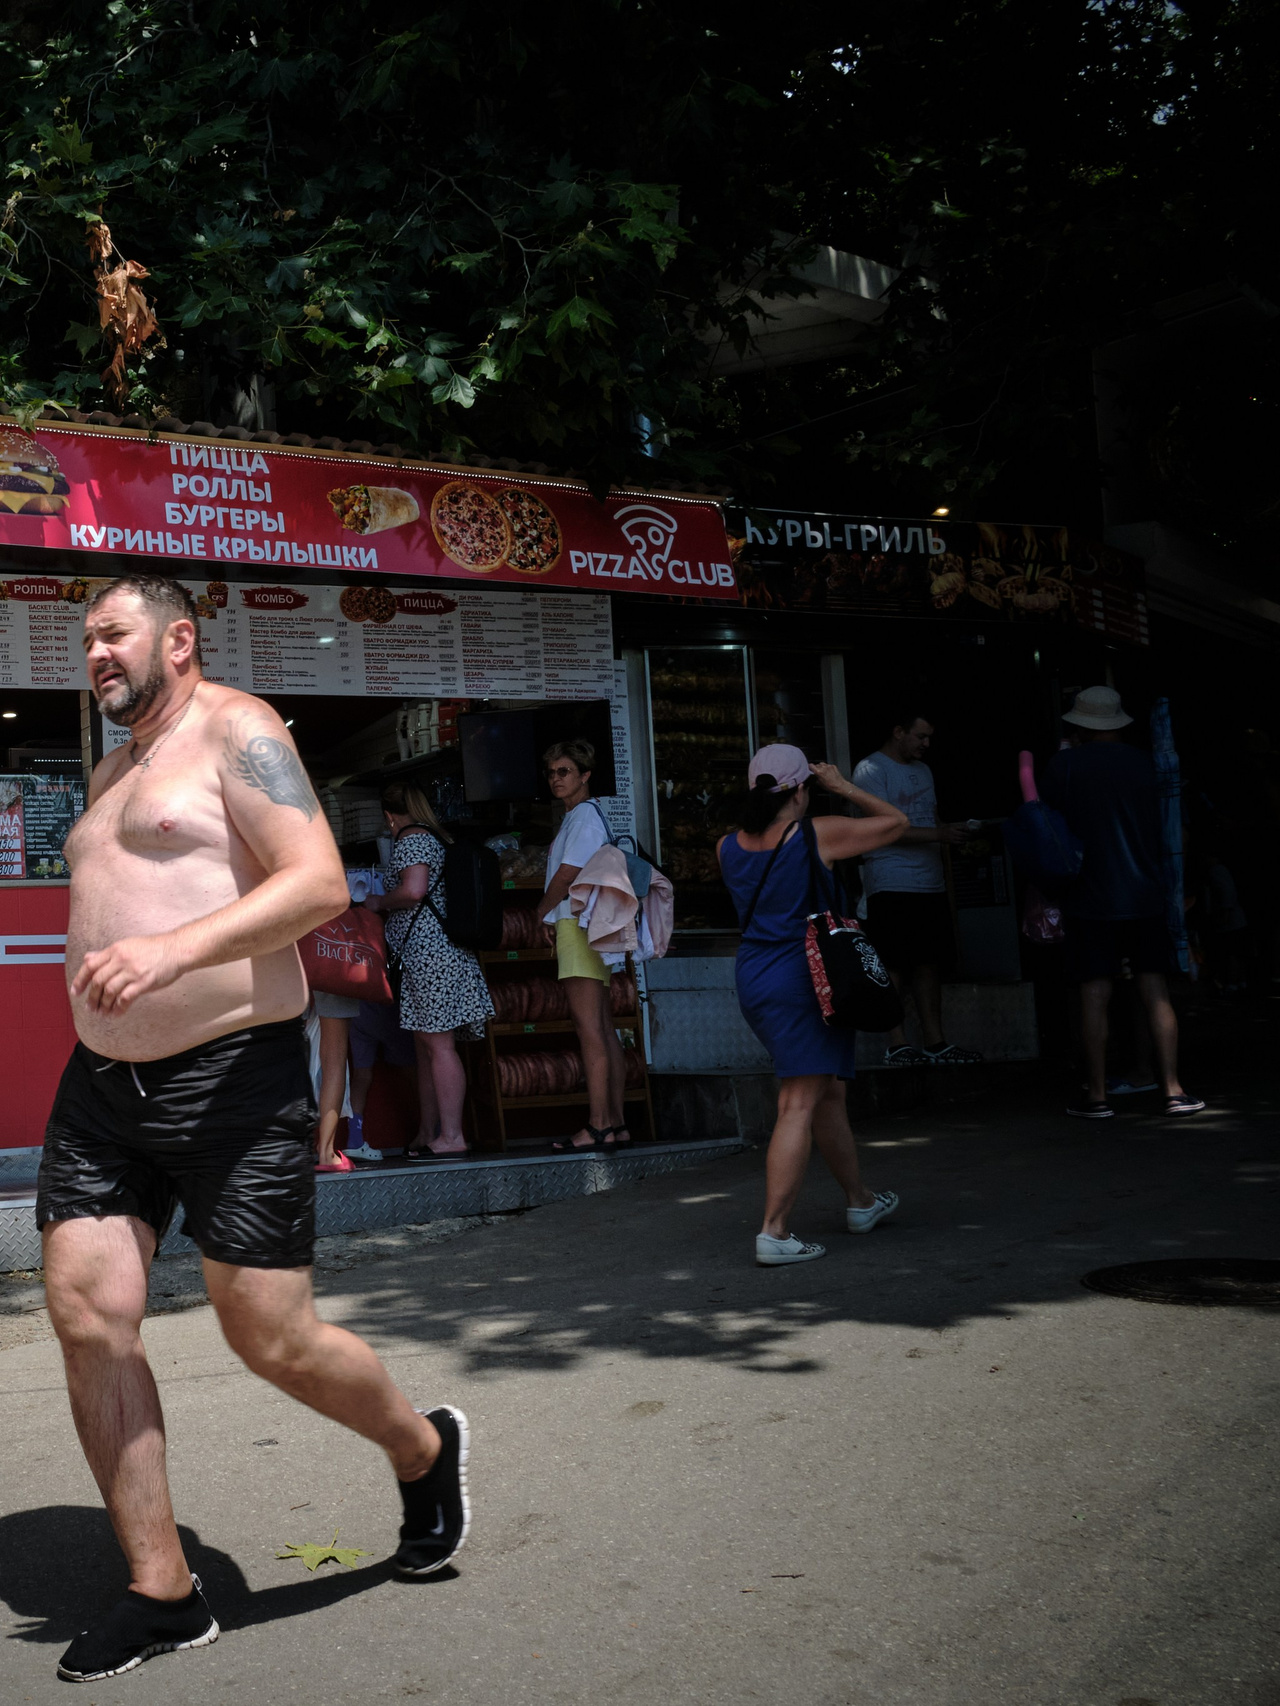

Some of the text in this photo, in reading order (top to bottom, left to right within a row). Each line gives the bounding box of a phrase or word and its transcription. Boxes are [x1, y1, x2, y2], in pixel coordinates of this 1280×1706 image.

[170, 445, 270, 476] ПИЦЦА
[173, 473, 272, 503] РОЛЛЫ
[165, 502, 285, 533] БУРГЕРЫ
[70, 524, 378, 569] КУРИНЫЕ КРЫЛЫШКИ
[570, 551, 734, 587] PIZZA CLUB
[14, 585, 56, 595] РОЛЛЫ
[255, 594, 293, 604] КОМБО
[404, 599, 444, 608] ПИЦЦА
[0, 839, 14, 849] 150
